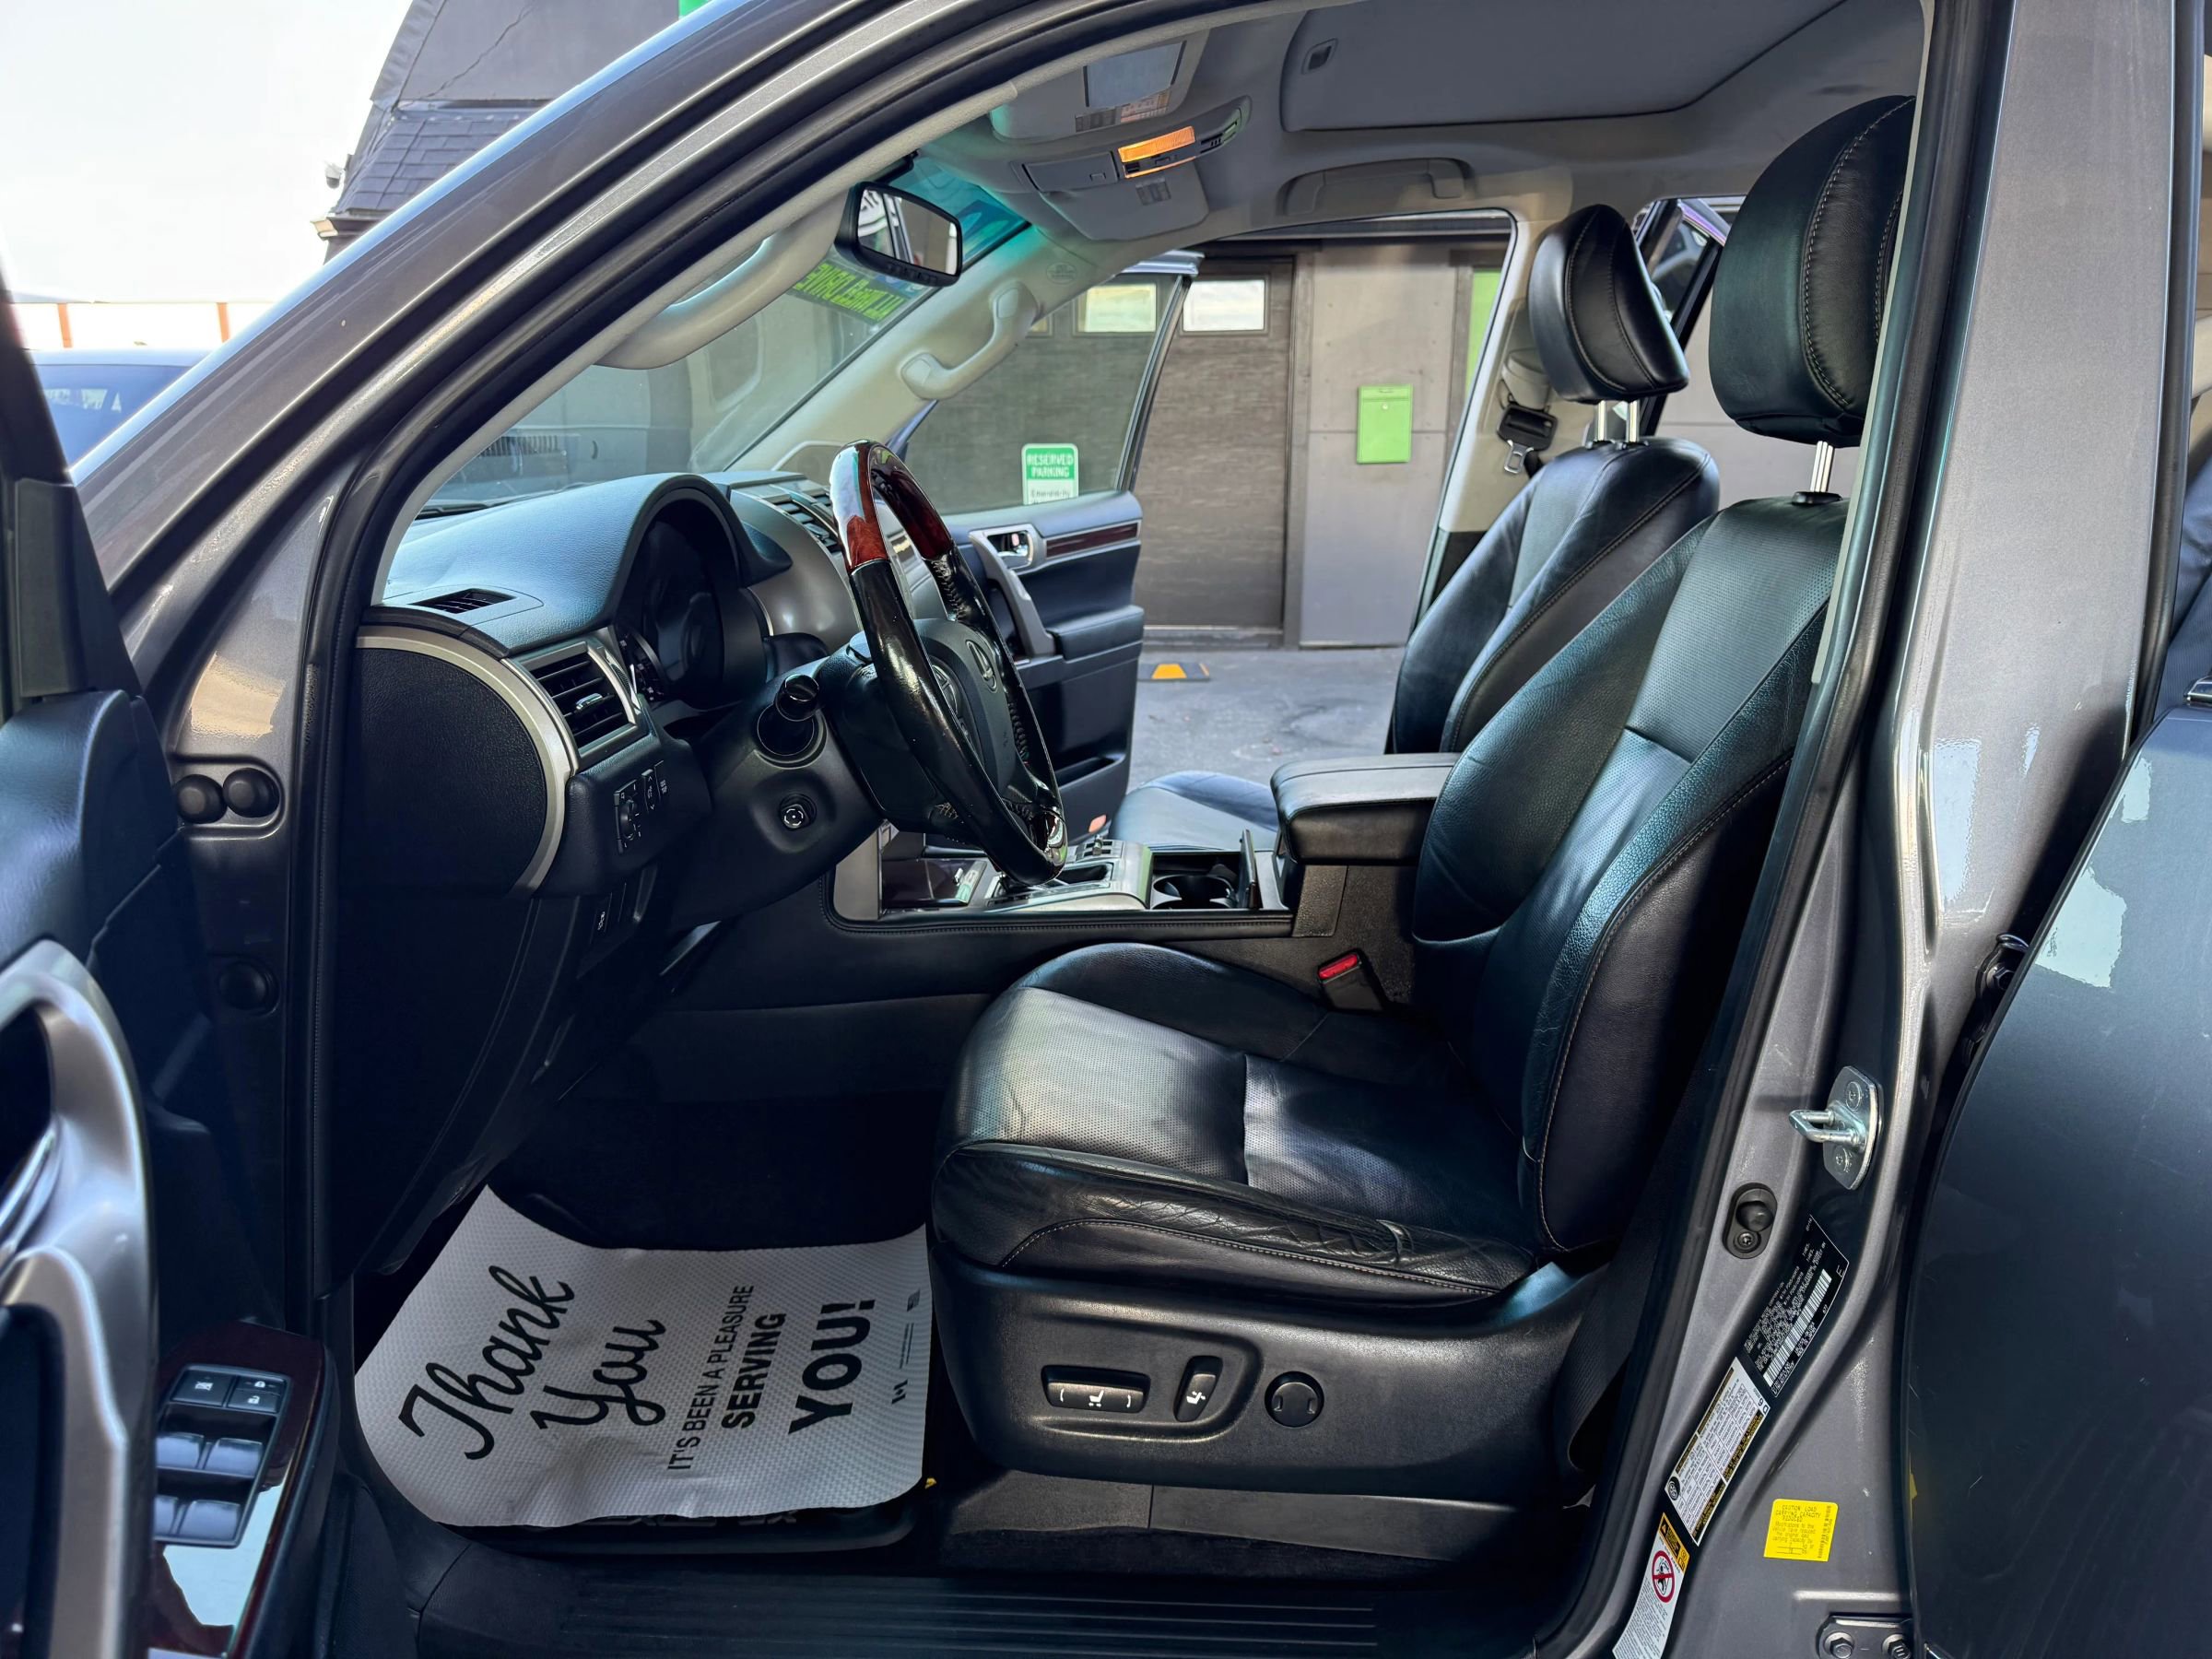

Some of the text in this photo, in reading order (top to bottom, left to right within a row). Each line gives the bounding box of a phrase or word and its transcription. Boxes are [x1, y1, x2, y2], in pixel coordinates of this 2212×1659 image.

[1027, 453, 1074, 465] RESERVED
[1031, 466, 1070, 477] PARKING
[398, 1265, 574, 1459] Thank
[530, 1320, 666, 1430] You
[667, 1286, 754, 1470] IT'S BEEN A PLEASURE
[721, 1313, 787, 1429] SERVING
[788, 1299, 876, 1435] YOU!
